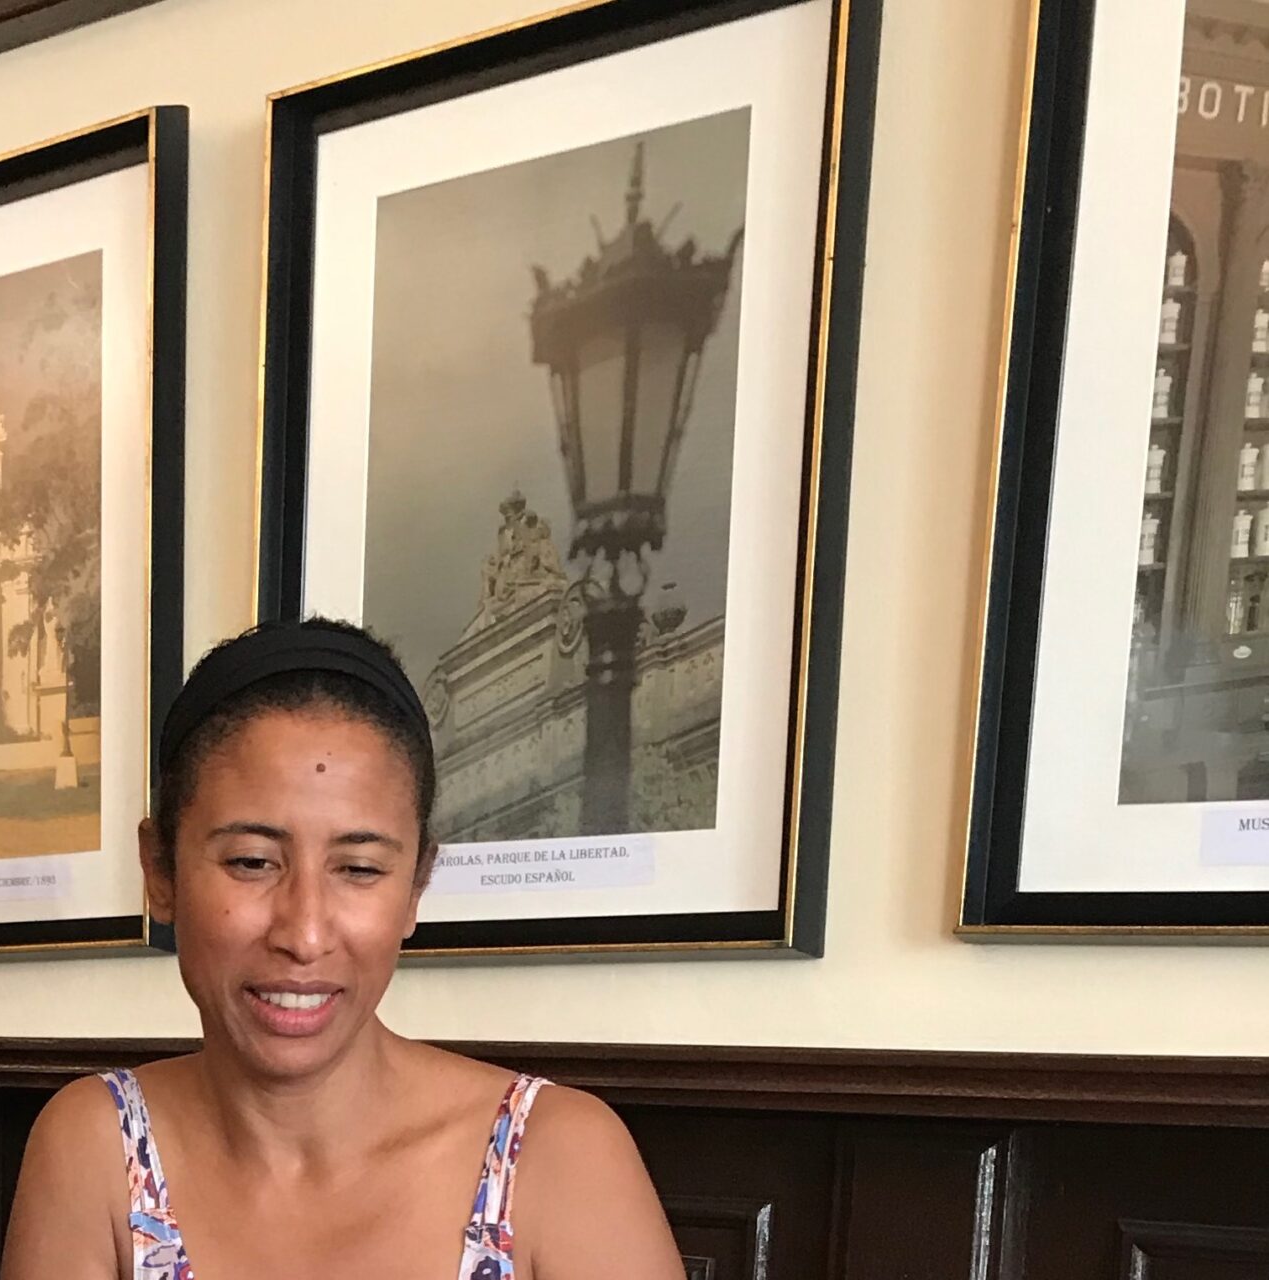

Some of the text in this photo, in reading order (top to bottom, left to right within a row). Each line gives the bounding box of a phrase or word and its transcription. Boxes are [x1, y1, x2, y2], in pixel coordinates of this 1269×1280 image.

[1238, 817, 1269, 832] MUS
[487, 851, 530, 865] PARQUE
[534, 850, 548, 862] DE
[551, 849, 566, 861] LA
[480, 868, 575, 885] ESCUDO ESPAÑOL
